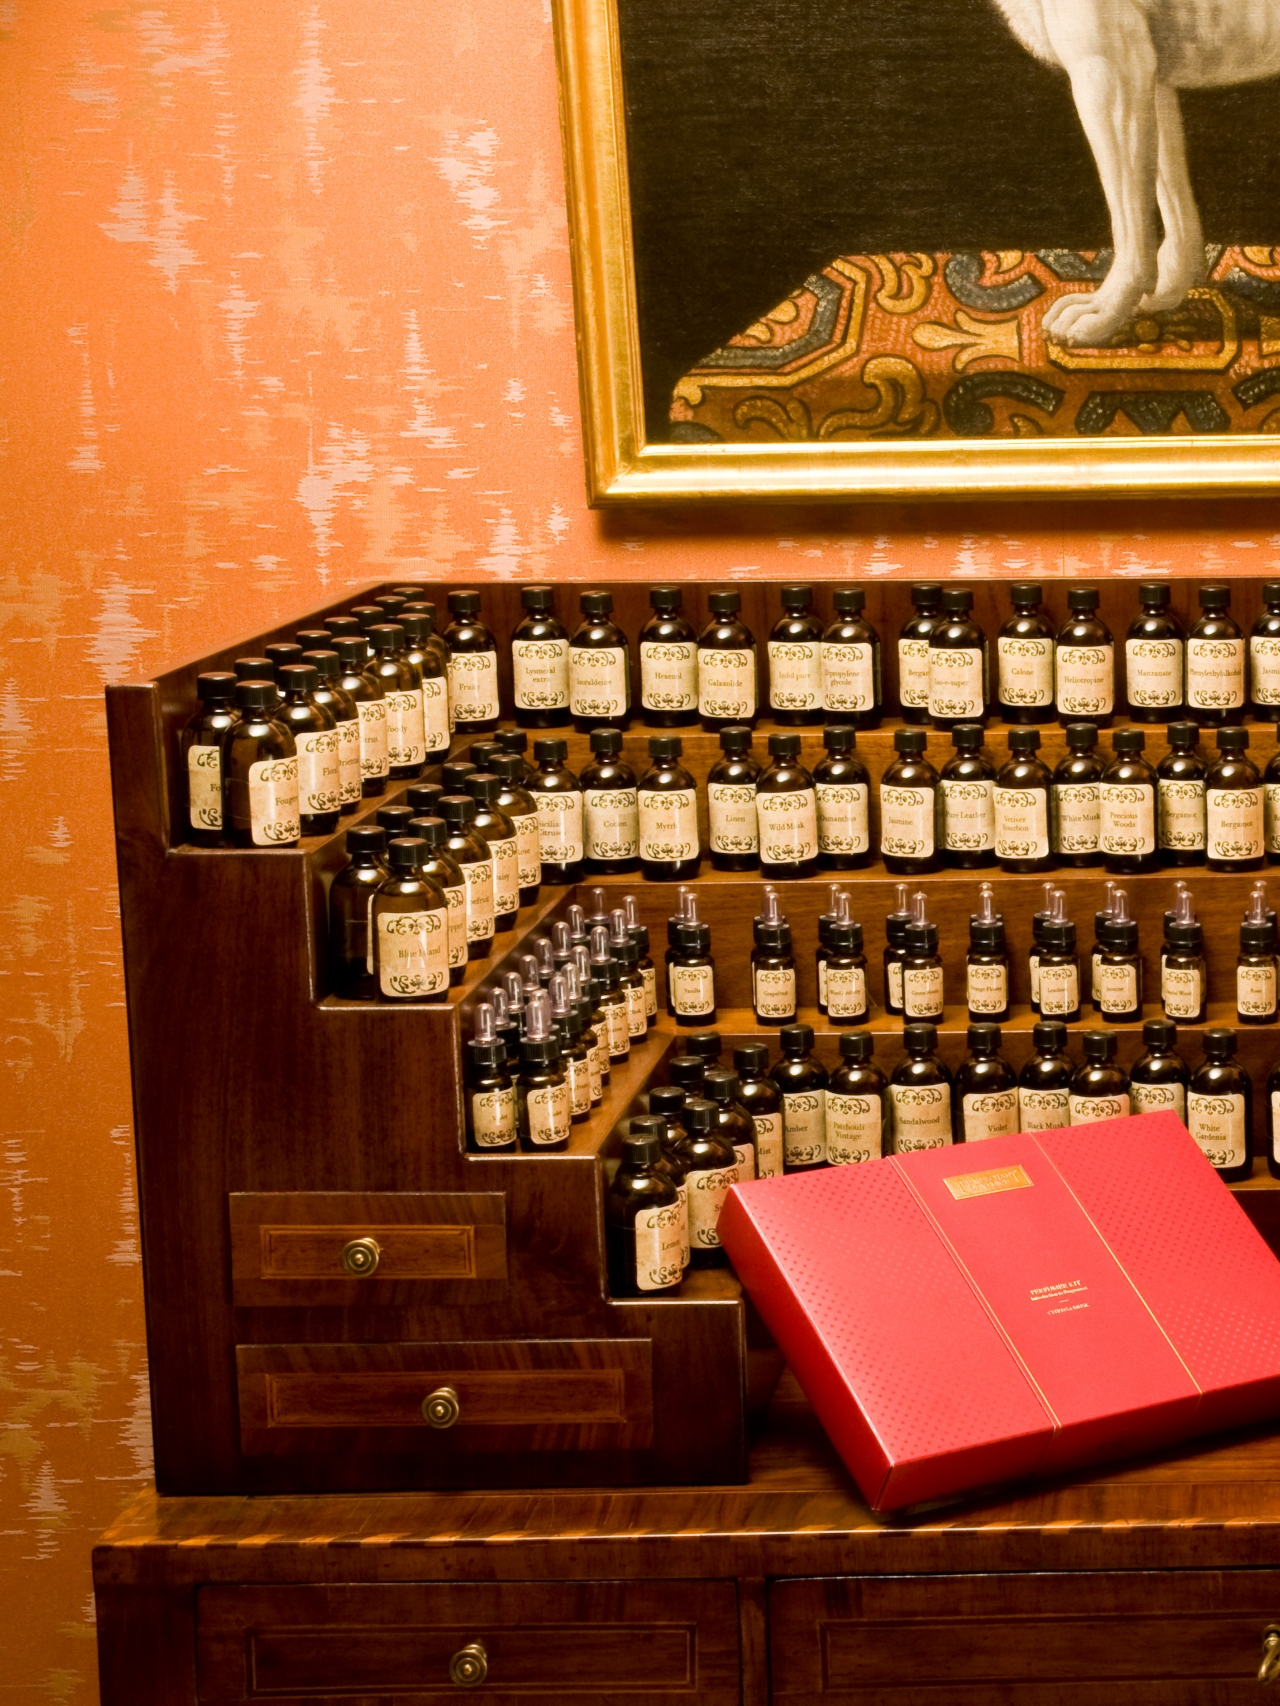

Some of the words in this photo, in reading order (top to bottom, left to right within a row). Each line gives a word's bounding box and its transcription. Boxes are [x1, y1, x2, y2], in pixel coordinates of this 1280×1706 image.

[654, 672, 682, 680] Hexenol
[908, 669, 929, 677] Berga
[1011, 667, 1034, 676] Calone
[819, 814, 857, 822] Osmanths
[888, 817, 914, 826] Jasmine
[603, 820, 628, 828] Coton
[787, 822, 805, 831] Msk
[1113, 820, 1136, 828] Woods
[1221, 820, 1253, 829] Bergamot
[899, 1117, 940, 1126] Sandalwood
[833, 1122, 865, 1131] Patchouli
[987, 1123, 1008, 1132] Violet
[1198, 1124, 1221, 1132] White
[834, 1131, 861, 1140] Vintage
[1195, 1132, 1227, 1141] Gardenia
